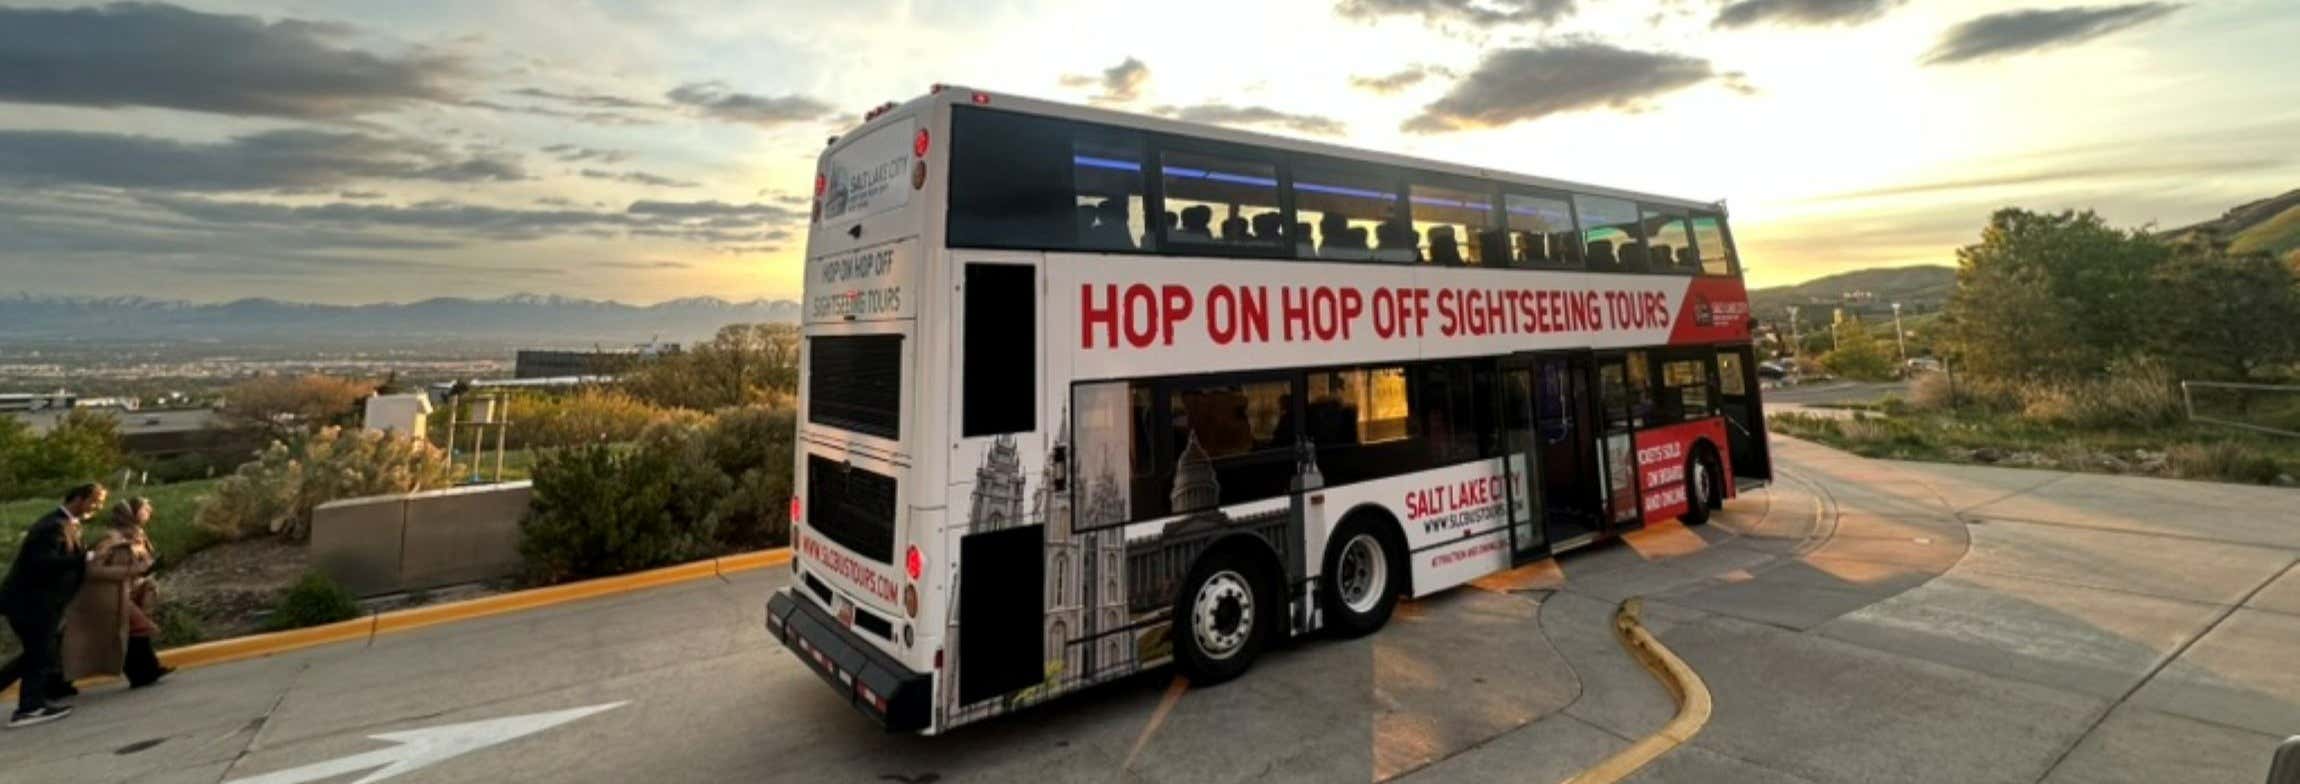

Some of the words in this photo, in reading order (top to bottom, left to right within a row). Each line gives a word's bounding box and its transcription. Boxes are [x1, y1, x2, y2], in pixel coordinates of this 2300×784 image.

[867, 285, 900, 313] TOURS
[1081, 283, 1194, 349] HOP
[1206, 284, 1269, 345] ON
[1281, 286, 1363, 342] HOP
[1372, 286, 1429, 339] OFF
[1437, 287, 1602, 337] SIGHTSEEING
[1605, 290, 1670, 331] TOURS
[1405, 486, 1445, 520] SALT
[1449, 478, 1487, 511] LAKE
